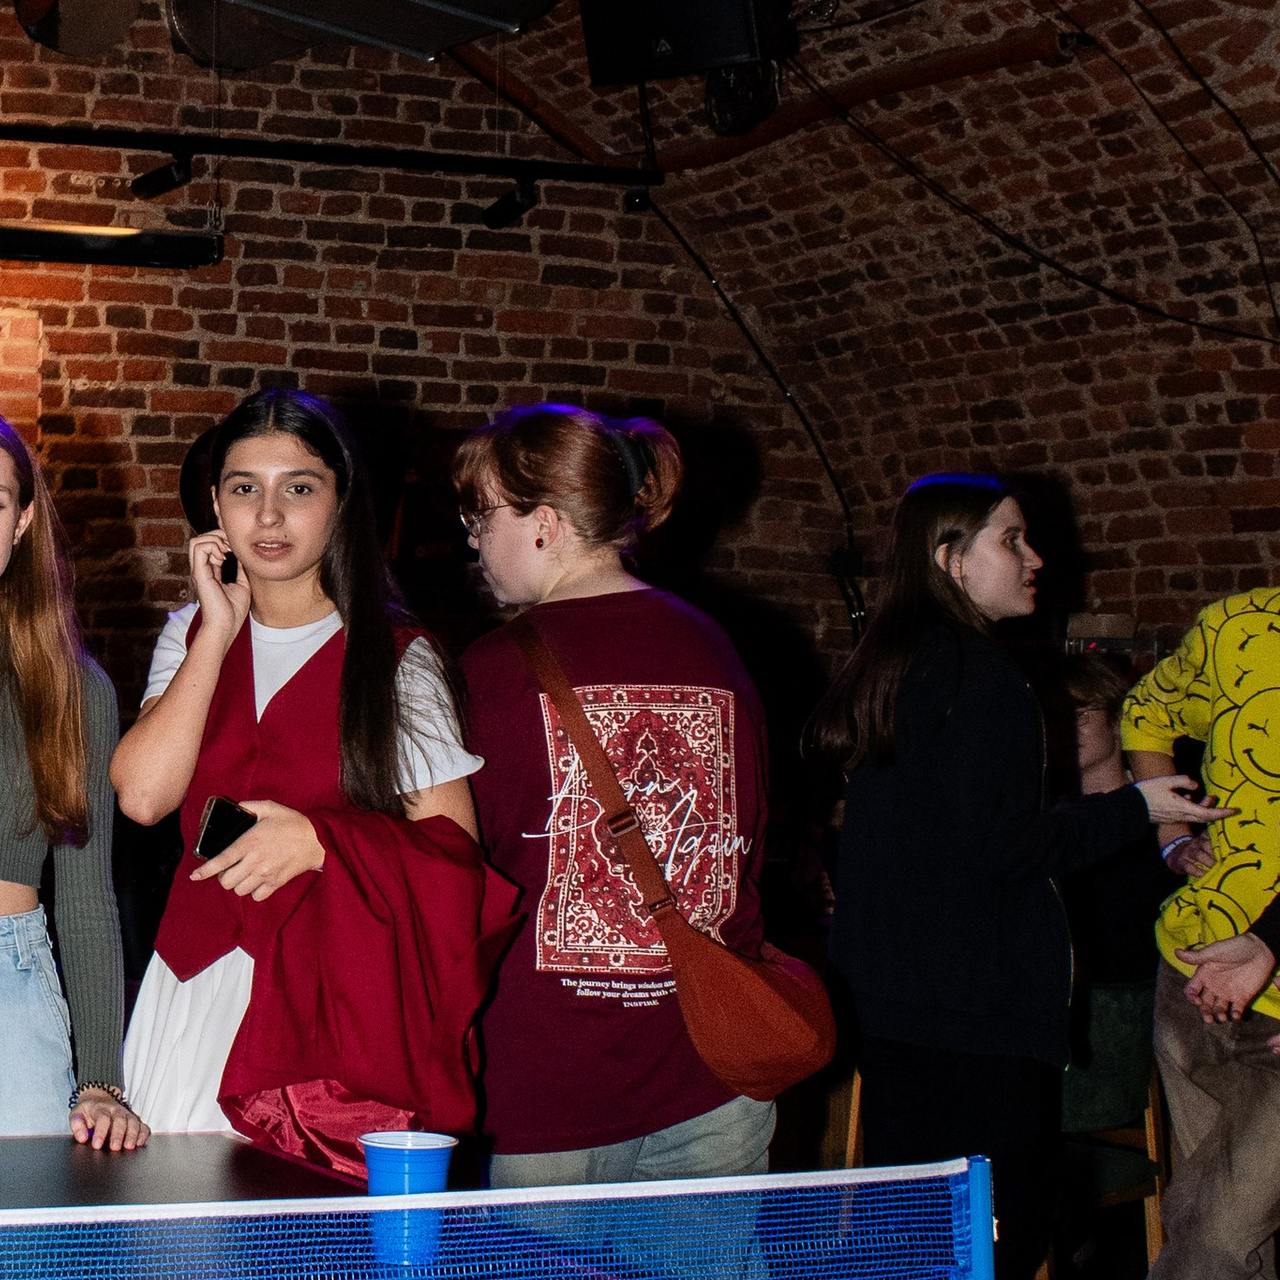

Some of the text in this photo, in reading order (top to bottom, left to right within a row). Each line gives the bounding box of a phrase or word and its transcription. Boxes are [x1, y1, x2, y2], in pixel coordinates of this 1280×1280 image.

[522, 752, 682, 839] Brn
[561, 978, 577, 987] The
[578, 978, 610, 989] journey
[611, 980, 637, 991] brings
[576, 988, 601, 997] follow
[602, 990, 621, 998] your
[621, 990, 650, 998] dreams
[650, 989, 669, 997] with
[623, 999, 659, 1008] INSPIRE
